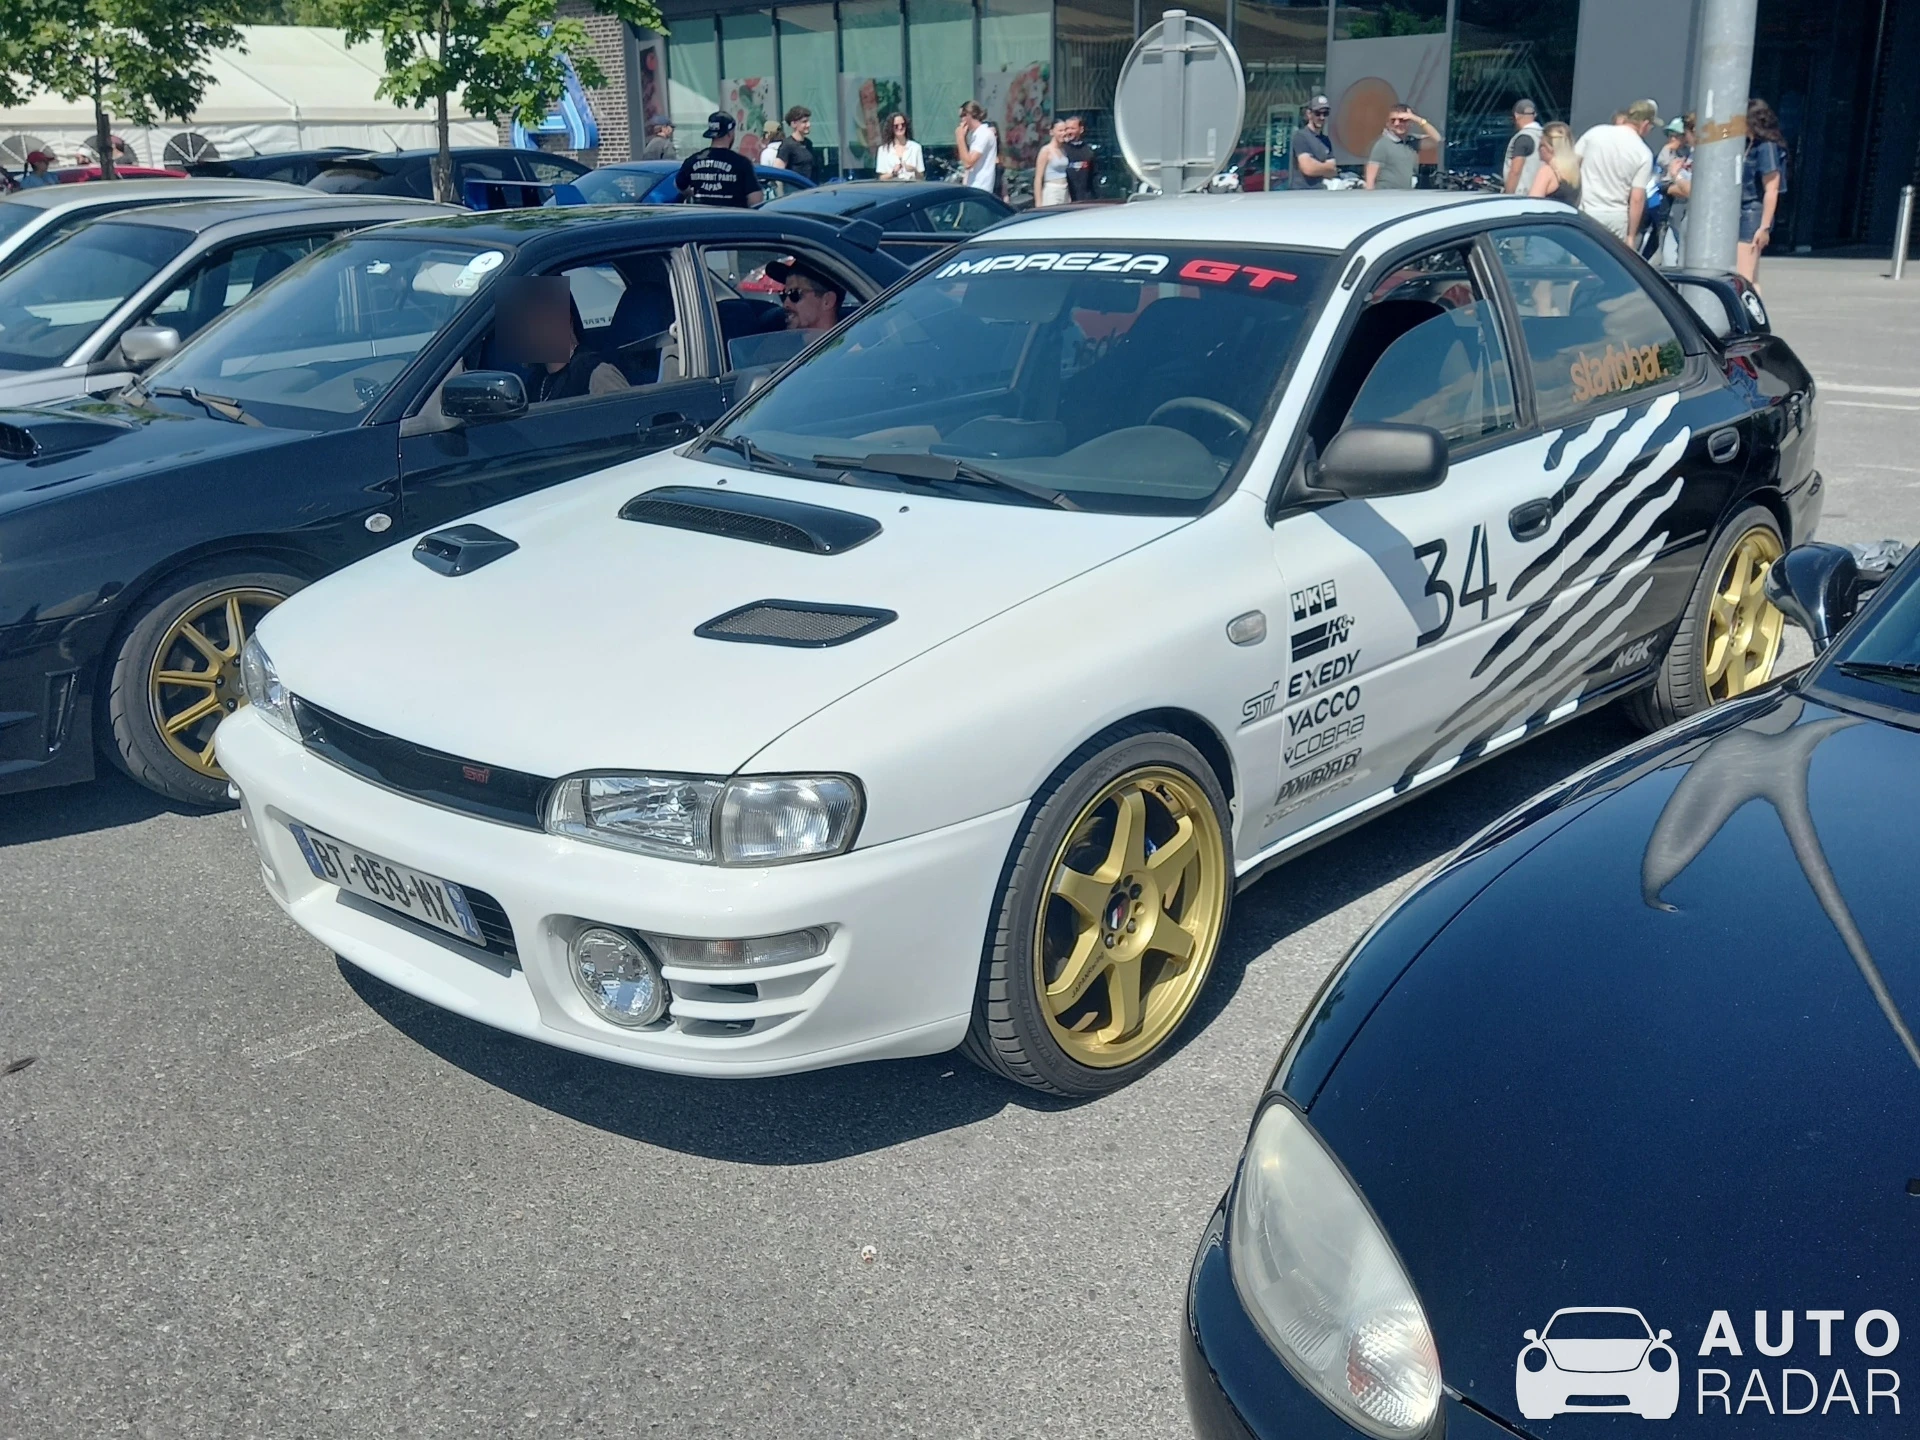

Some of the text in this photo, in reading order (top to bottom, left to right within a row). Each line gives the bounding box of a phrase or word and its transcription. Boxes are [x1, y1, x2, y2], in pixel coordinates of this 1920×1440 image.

[701, 182, 722, 191] JAPAN
[718, 174, 737, 182] PARTS
[935, 252, 1298, 288] IMPREZA GT
[1290, 579, 1337, 620] HKS
[1415, 520, 1498, 648] 34
[1328, 614, 1355, 648] K&N
[1288, 648, 1361, 699] EXEDY
[1610, 635, 1658, 674] NGK
[1288, 685, 1361, 737] YACCO
[1294, 714, 1366, 760] COBRA
[457, 911, 479, 935] 74
